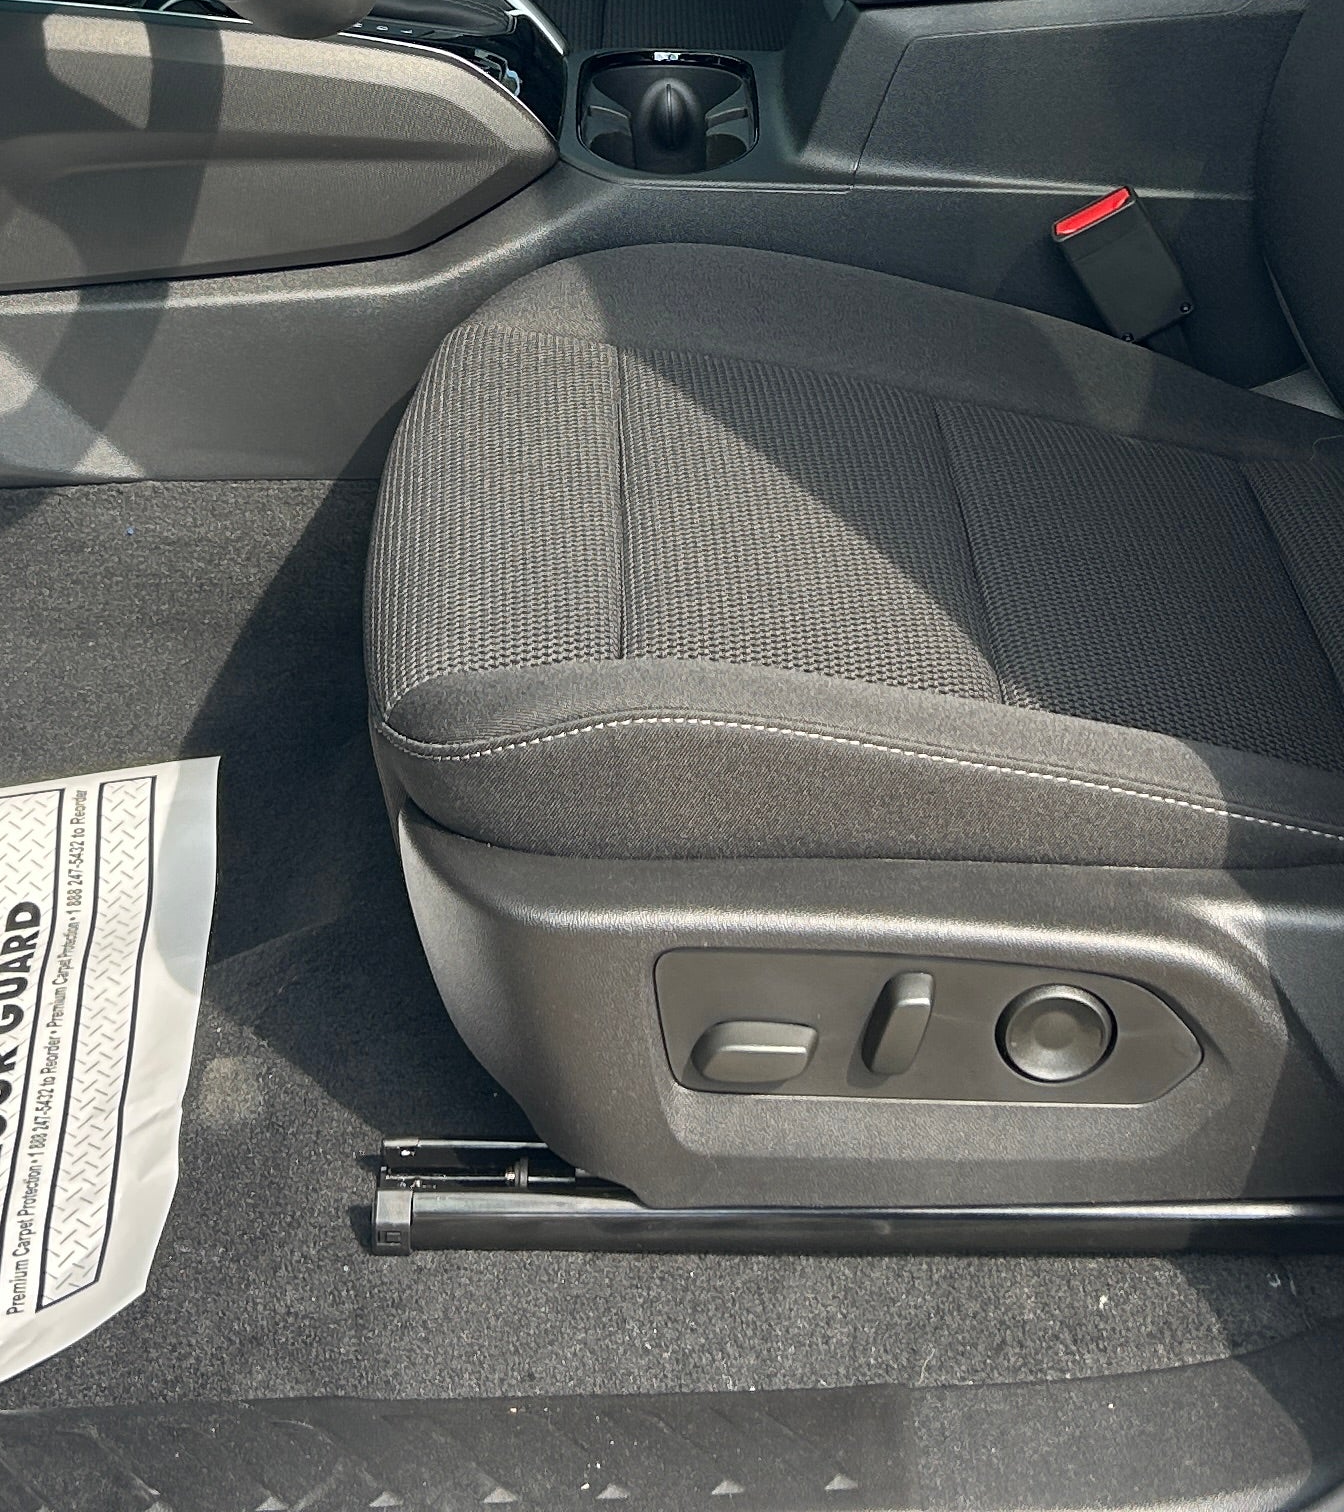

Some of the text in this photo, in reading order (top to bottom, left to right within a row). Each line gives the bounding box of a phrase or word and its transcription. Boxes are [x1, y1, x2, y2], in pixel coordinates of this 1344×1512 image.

[70, 788, 88, 827] Reorder
[72, 826, 85, 838] to
[67, 840, 85, 887] 247-5432
[67, 888, 83, 909] 888
[62, 921, 80, 958] Protection
[52, 954, 72, 986] Carpet
[46, 987, 67, 1030] Premium
[40, 1035, 61, 1075] Reorder
[42, 1074, 56, 1088] to
[32, 1088, 55, 1130] 247-5432
[29, 1129, 47, 1150] 888
[17, 1166, 42, 1217] Protection
[12, 1218, 36, 1258] Carpet
[6, 1260, 29, 1316] Premium
